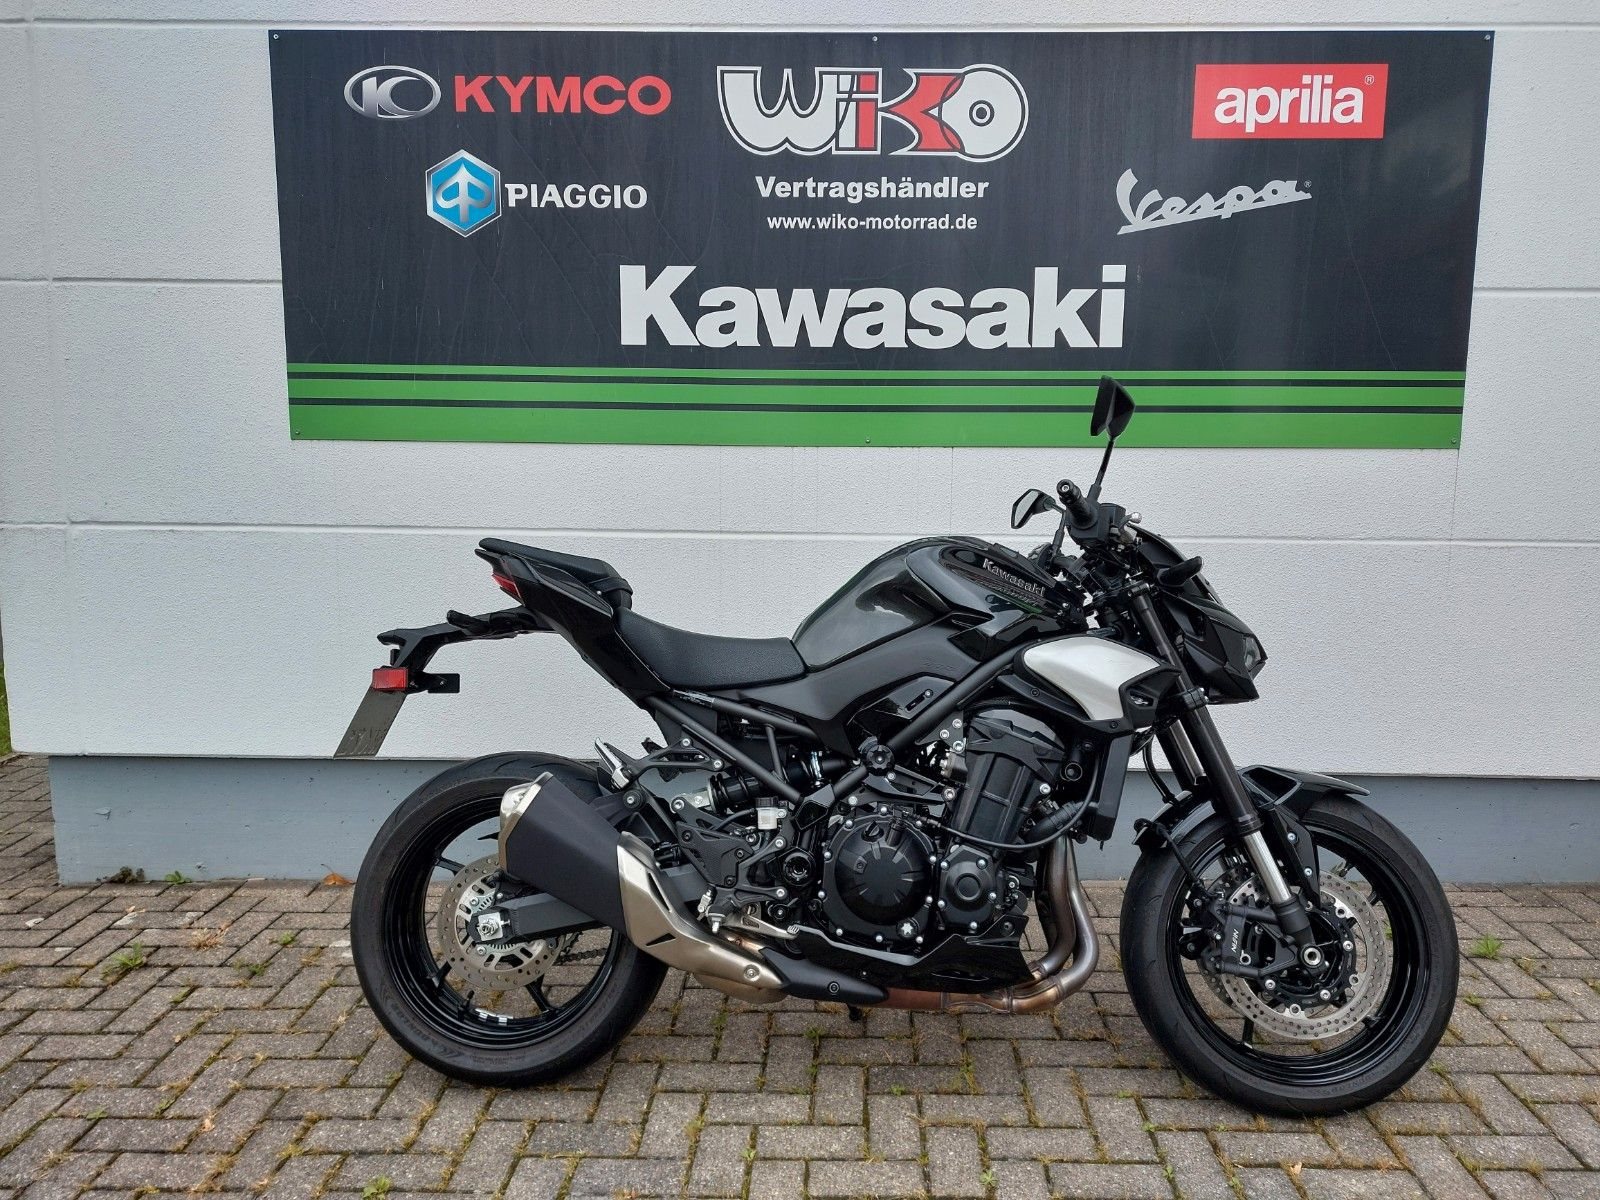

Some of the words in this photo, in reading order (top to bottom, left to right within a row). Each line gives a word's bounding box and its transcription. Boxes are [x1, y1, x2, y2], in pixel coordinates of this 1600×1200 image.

[454, 74, 672, 115] KYMCO
[1214, 74, 1364, 133] aprilia
[505, 183, 648, 209] PIAGGIO
[755, 175, 990, 203] Vertragshändler
[1116, 168, 1312, 235] Vespa
[767, 213, 978, 230] www.wiko-motorrad.de
[619, 264, 1127, 350] Kawasaki
[982, 558, 1046, 596] Kawasaki
